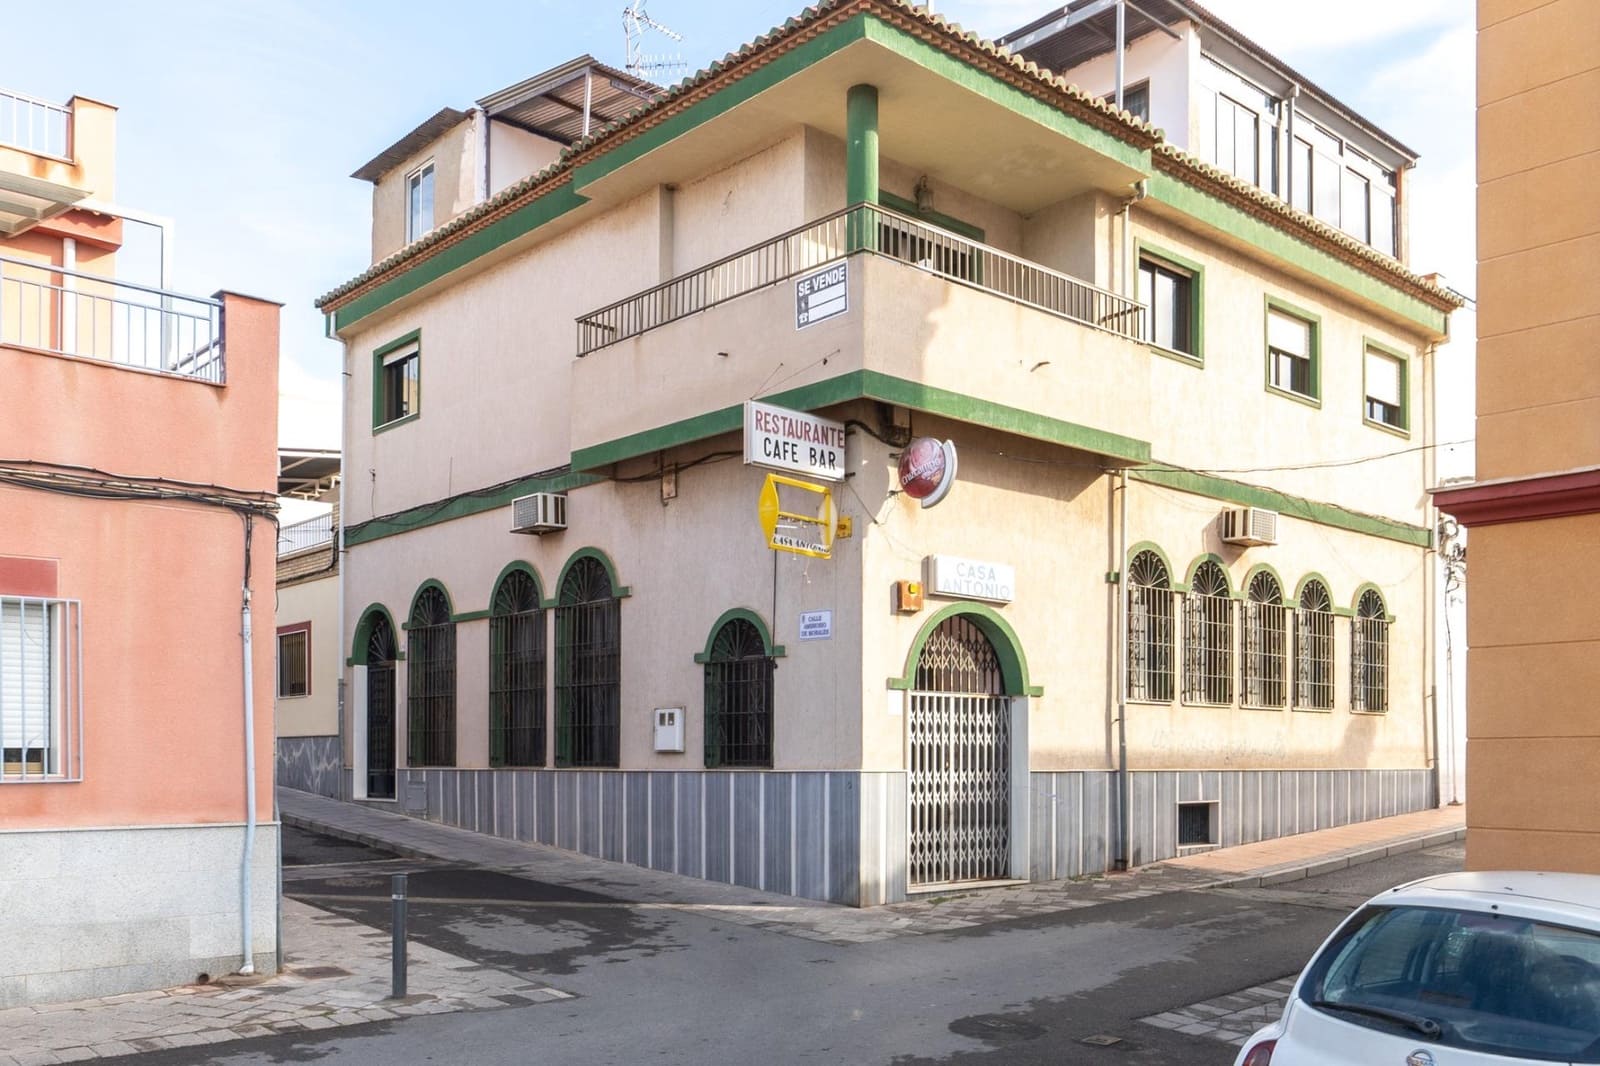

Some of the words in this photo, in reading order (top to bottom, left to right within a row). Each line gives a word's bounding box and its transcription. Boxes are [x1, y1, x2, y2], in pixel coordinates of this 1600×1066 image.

[798, 280, 811, 297] SE
[812, 266, 845, 292] VENDE
[755, 410, 845, 449] RESTAURANTE
[763, 437, 799, 464] CAFE
[809, 447, 836, 471] BAR
[956, 562, 997, 582] CASA
[943, 578, 1010, 600] ANTONIO
